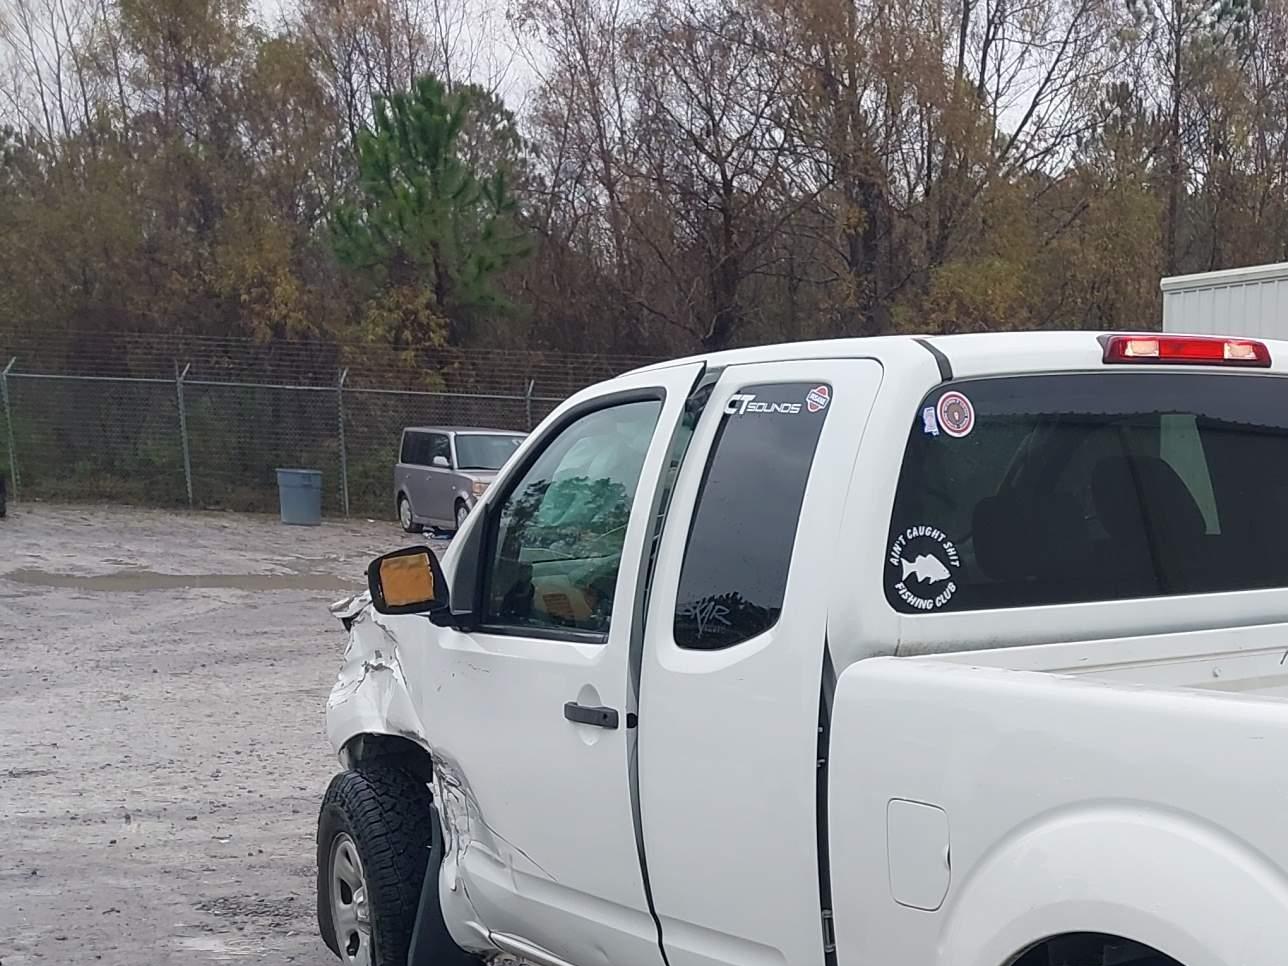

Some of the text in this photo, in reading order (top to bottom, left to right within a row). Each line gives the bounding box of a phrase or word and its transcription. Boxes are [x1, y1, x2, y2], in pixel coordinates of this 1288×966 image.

[724, 393, 802, 415] CT SOUNDS
[889, 525, 961, 568] AIN'T CAUGHT SHIT
[894, 581, 957, 610] FISHING CLUB
